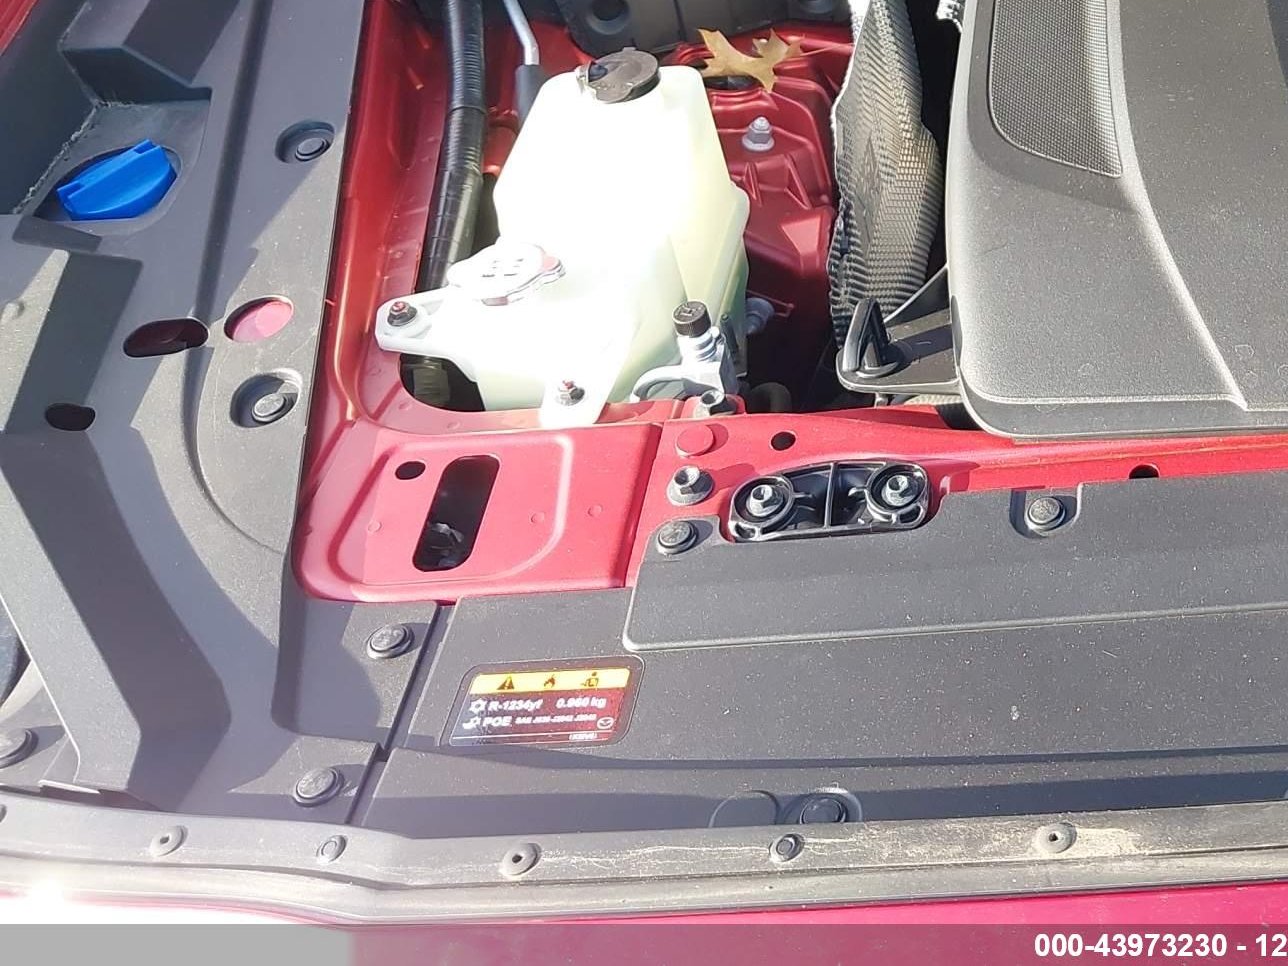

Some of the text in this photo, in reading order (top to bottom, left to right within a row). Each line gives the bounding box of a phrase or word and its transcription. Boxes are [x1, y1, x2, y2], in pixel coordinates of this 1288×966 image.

[487, 699, 544, 711] R-1234yf
[591, 697, 607, 709] kg
[482, 716, 512, 727] POE
